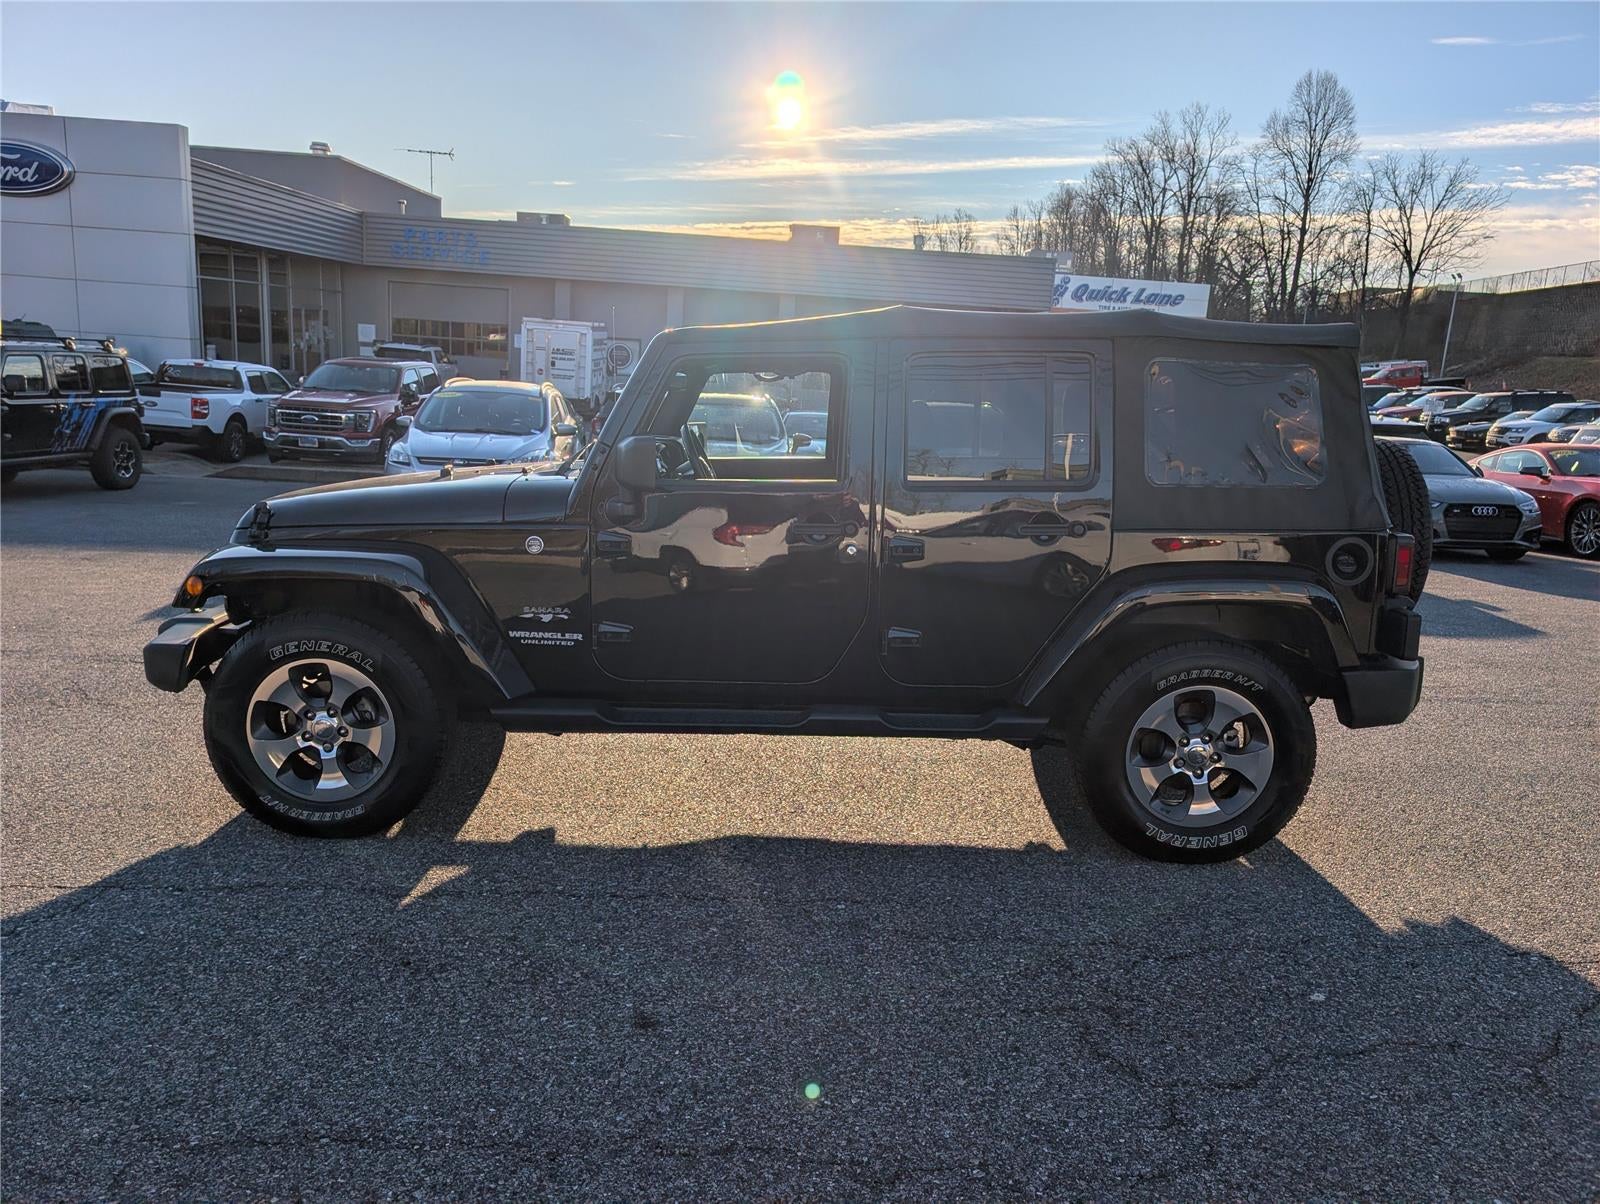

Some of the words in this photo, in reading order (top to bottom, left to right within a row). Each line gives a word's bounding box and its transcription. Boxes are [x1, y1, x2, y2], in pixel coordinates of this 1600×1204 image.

[404, 229, 478, 245] PARTS
[392, 243, 490, 264] SERVICE
[1071, 283, 1132, 304] Quick
[1131, 288, 1185, 307] Lane
[523, 606, 571, 614] SAHARA
[508, 630, 583, 640] WRANGLER
[269, 640, 375, 672] GENERAL
[1156, 669, 1234, 691] GRABBER
[1146, 823, 1248, 848] GENERAL
